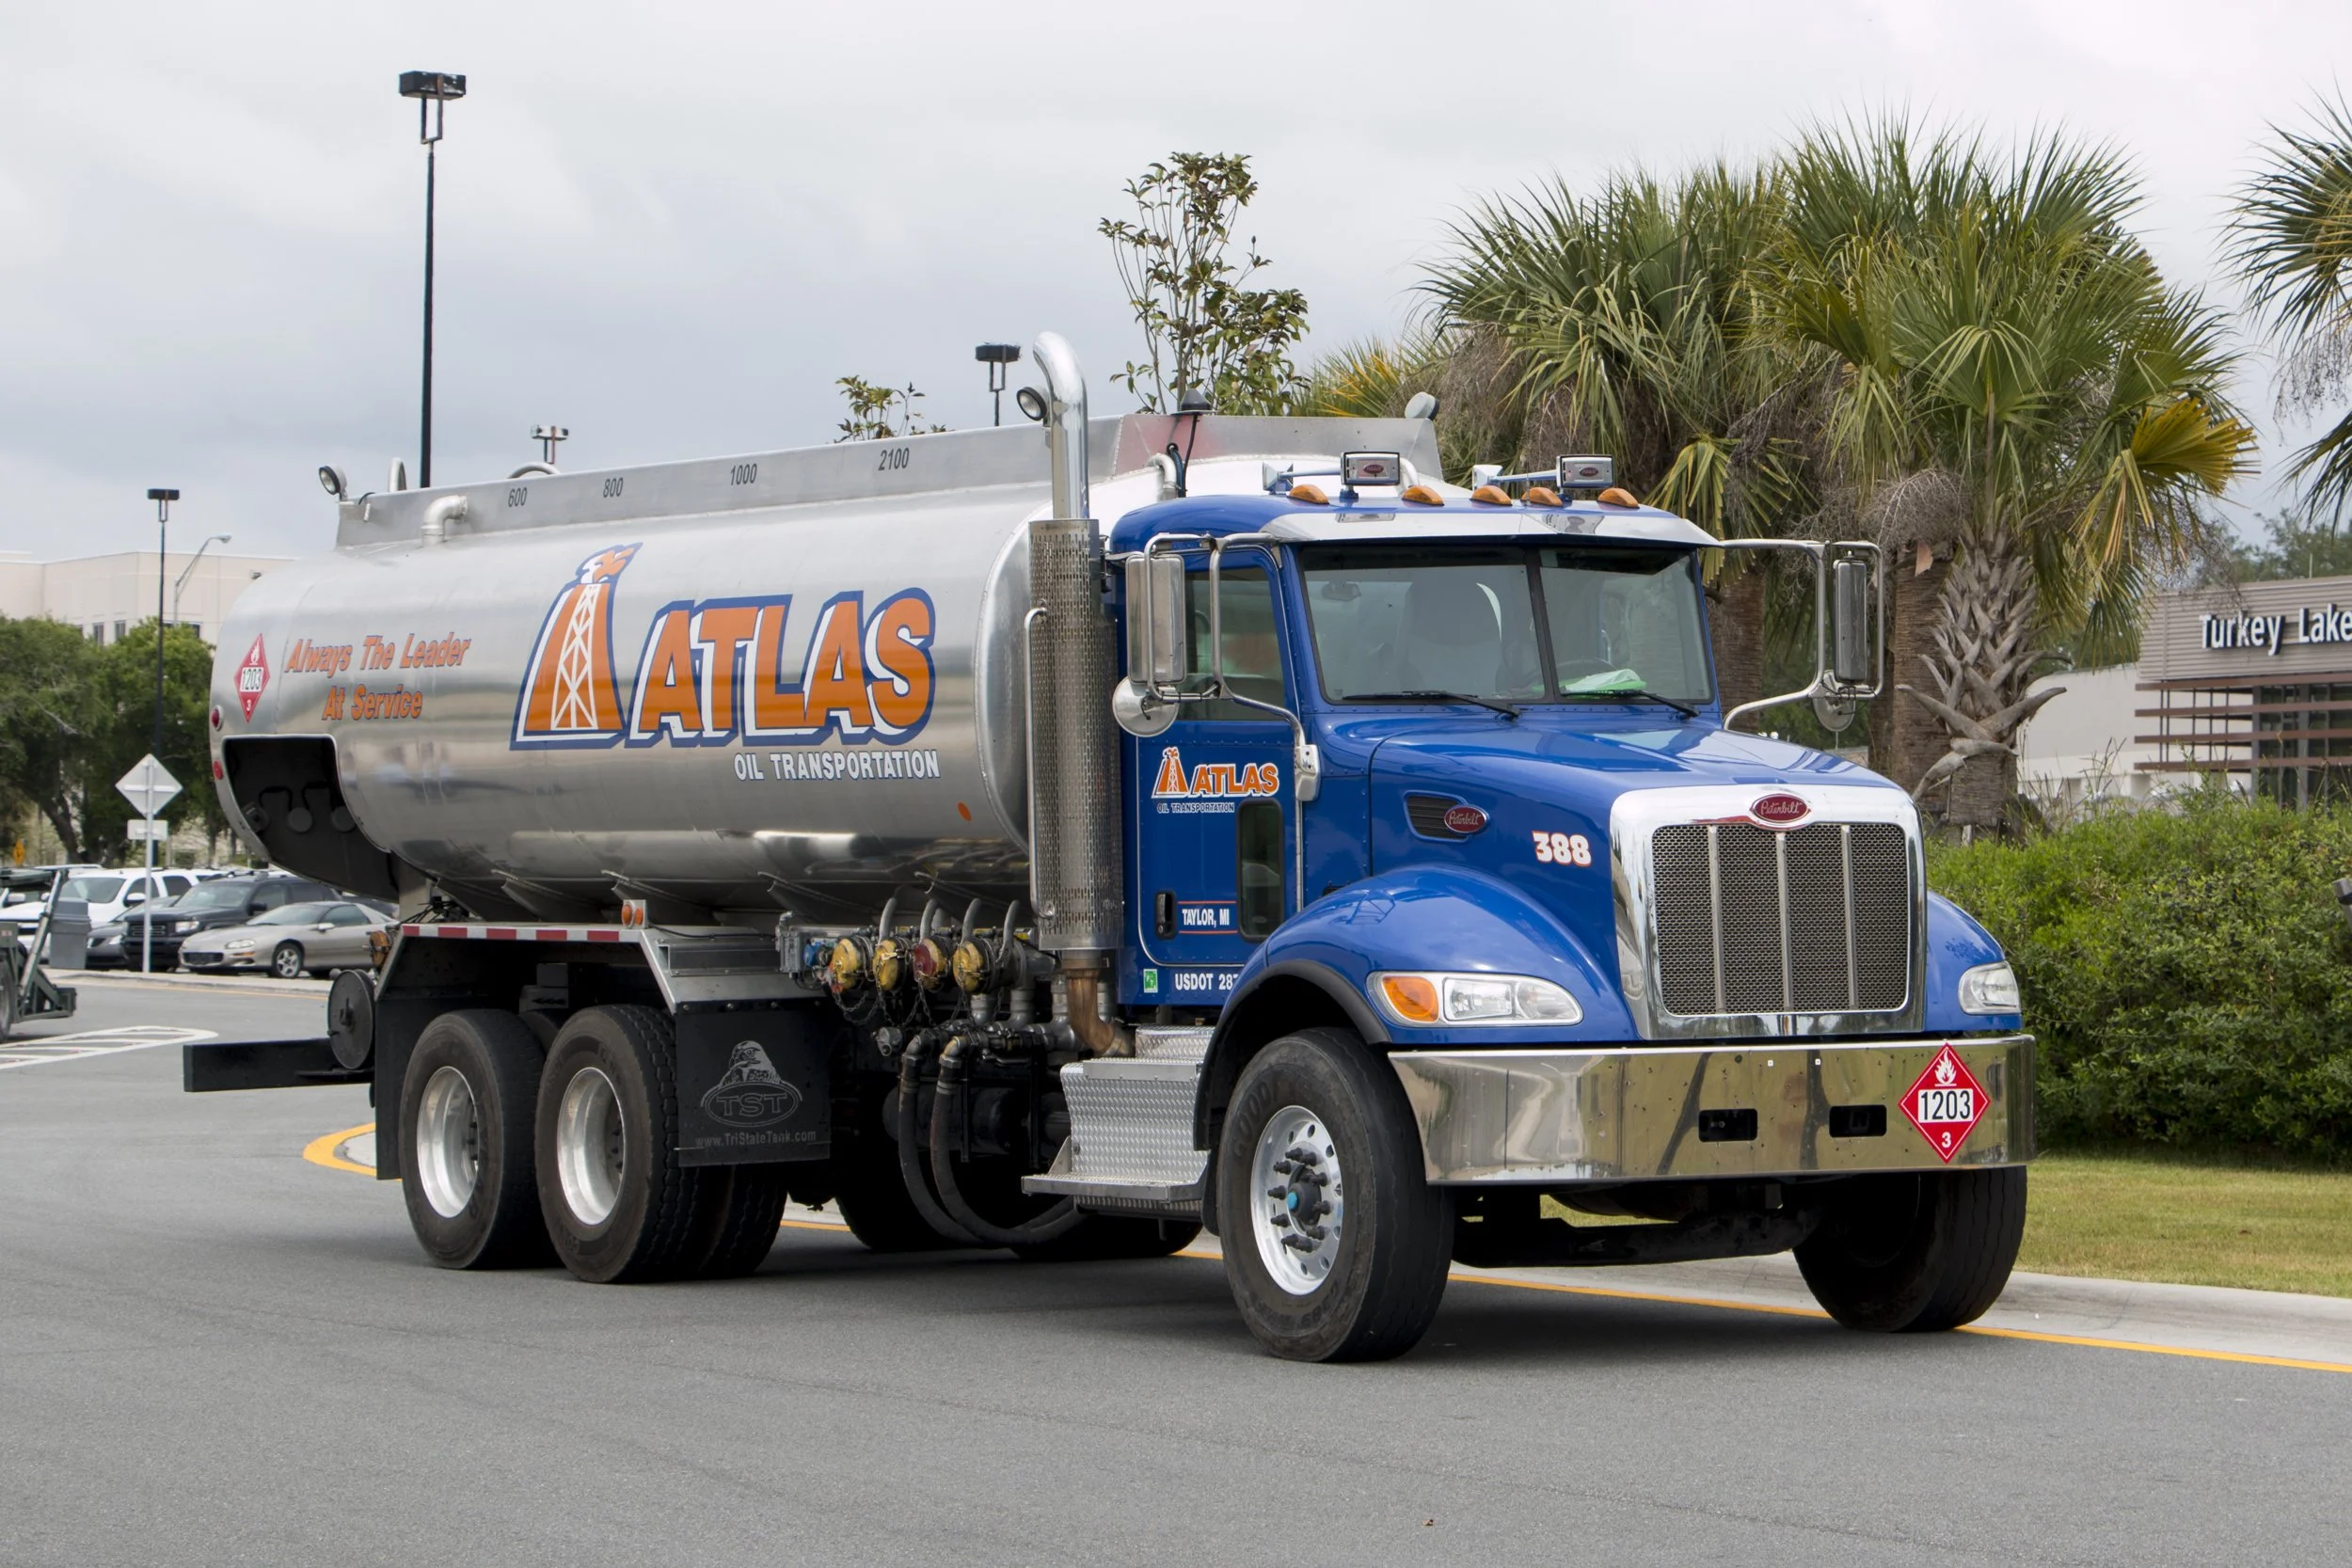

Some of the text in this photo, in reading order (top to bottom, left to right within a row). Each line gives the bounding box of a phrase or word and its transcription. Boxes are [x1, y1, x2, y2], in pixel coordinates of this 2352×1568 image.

[878, 448, 909, 470] 2100
[730, 463, 757, 485] 1000
[508, 486, 527, 507] 600
[602, 477, 624, 498] 800
[2200, 610, 2285, 657] Turkey
[284, 632, 471, 678] Always The Leader
[242, 668, 262, 690] 1203
[625, 587, 936, 749] ATLAS
[246, 699, 252, 711] 3
[321, 684, 423, 721] At Service
[734, 750, 940, 781] OIL TRANSPORTATION
[1187, 763, 1279, 798] ATLAS
[1157, 801, 1235, 814] OIL TRANSPORTATION
[1449, 810, 1482, 826] Peterbilt
[1760, 800, 1803, 816] Peterbilt
[1532, 831, 1592, 866] 388
[1182, 908, 1230, 928] TAYLOR, MI
[1174, 974, 1214, 990] USDOT
[716, 1092, 787, 1117] TST
[1920, 1090, 1970, 1119] 1203
[695, 1131, 817, 1148] www.TriStateTank.com
[1941, 1132, 1951, 1148] 3
